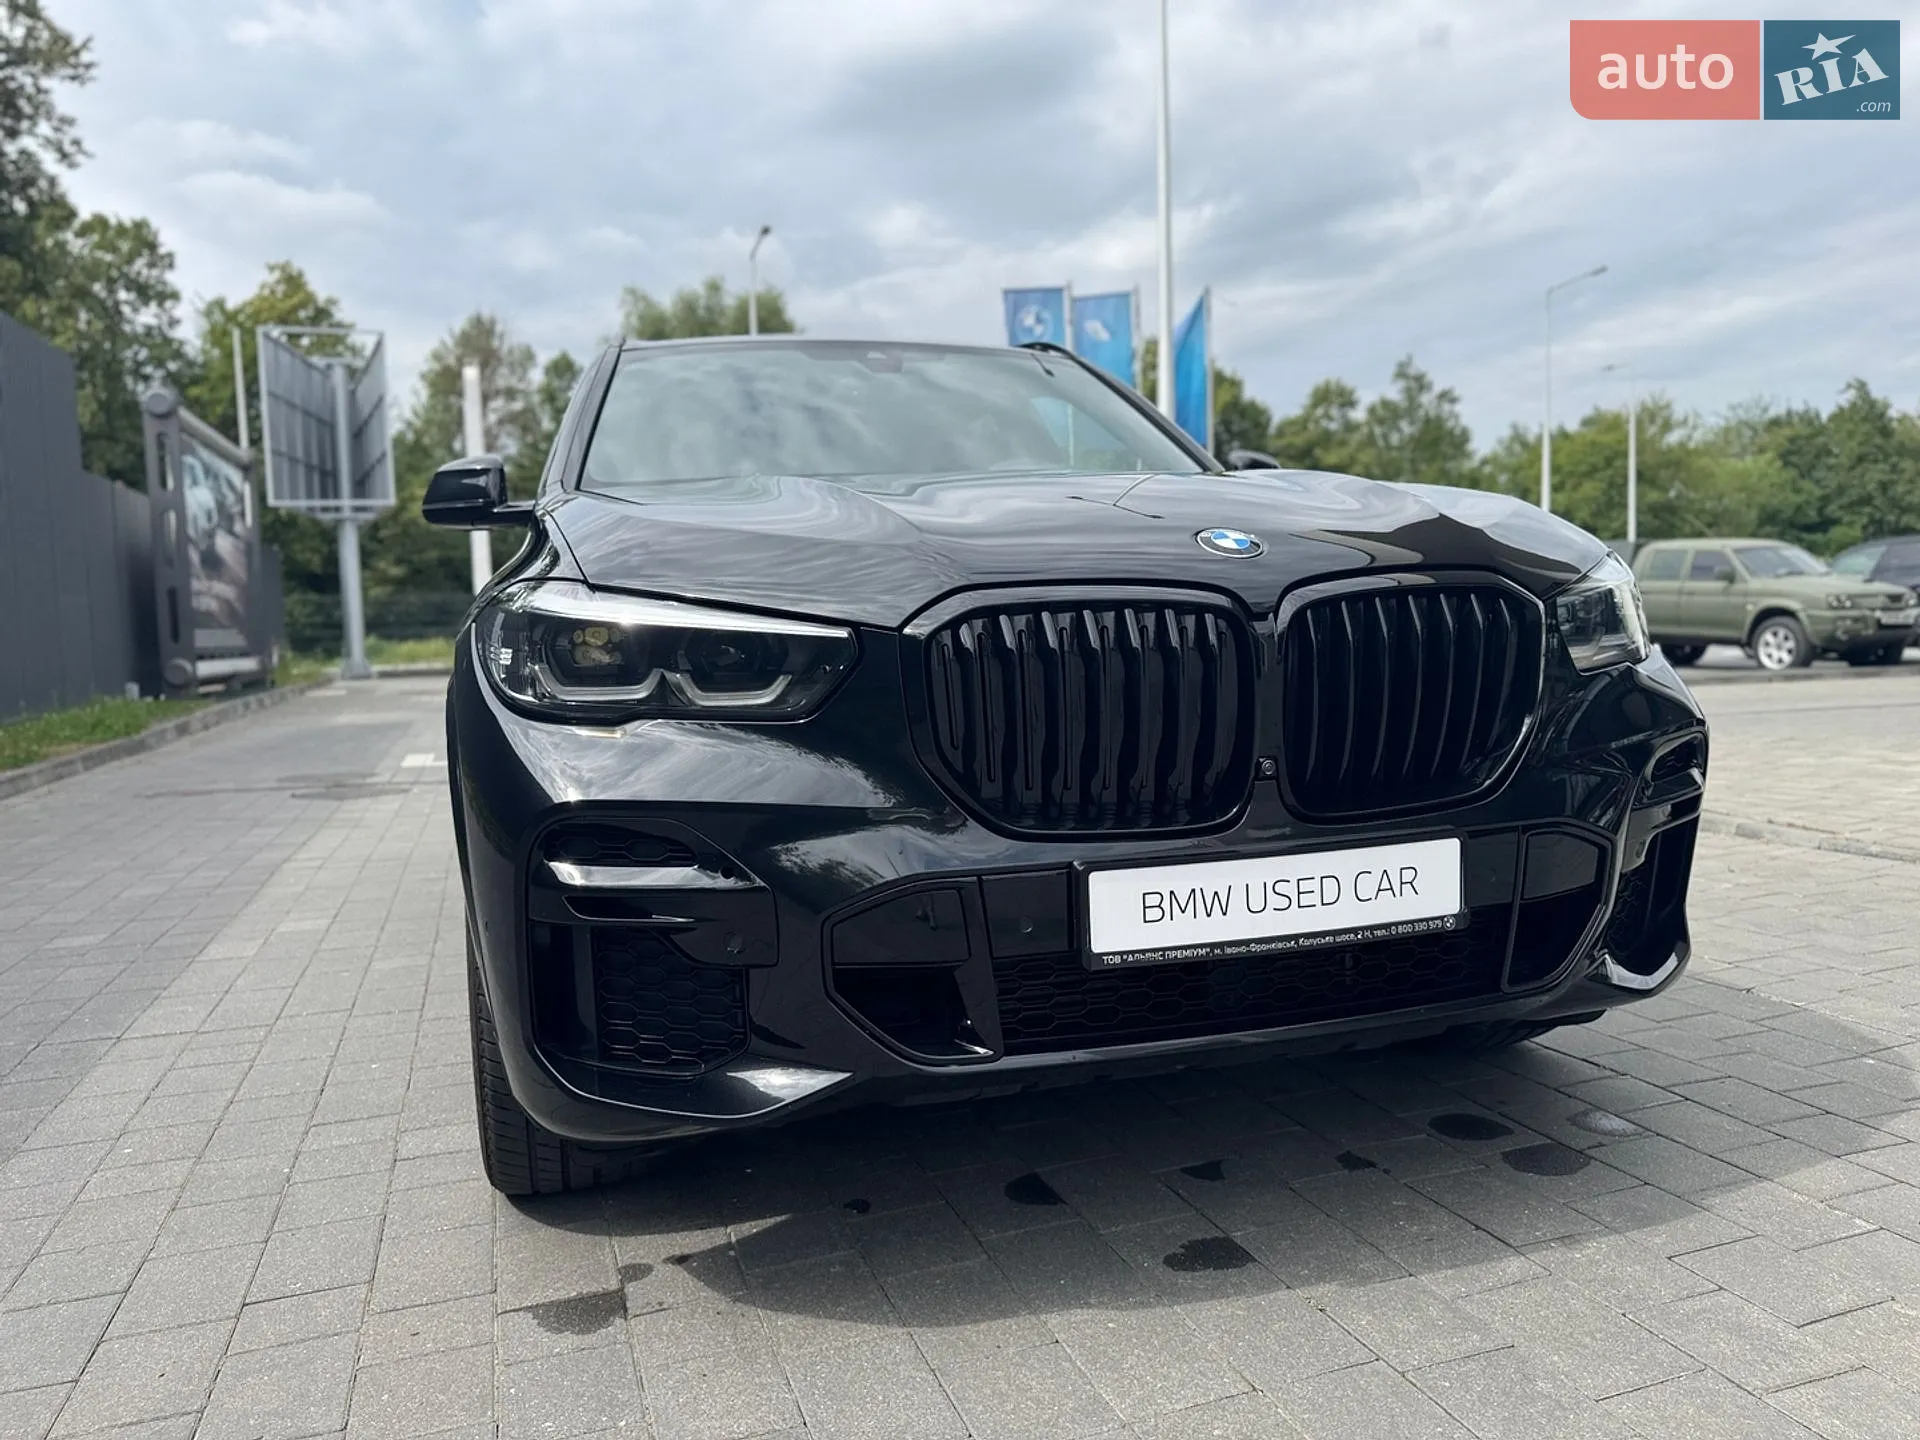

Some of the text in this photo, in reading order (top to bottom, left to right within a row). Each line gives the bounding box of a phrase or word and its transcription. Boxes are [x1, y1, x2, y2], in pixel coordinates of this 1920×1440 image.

[1142, 866, 1419, 924] BMW USED CAR
[1102, 954, 1121, 965] ТОВ
[1357, 930, 1363, 939] 2
[1390, 925, 1397, 935] 0
[1397, 923, 1413, 934] 800
[1413, 921, 1428, 932] 330
